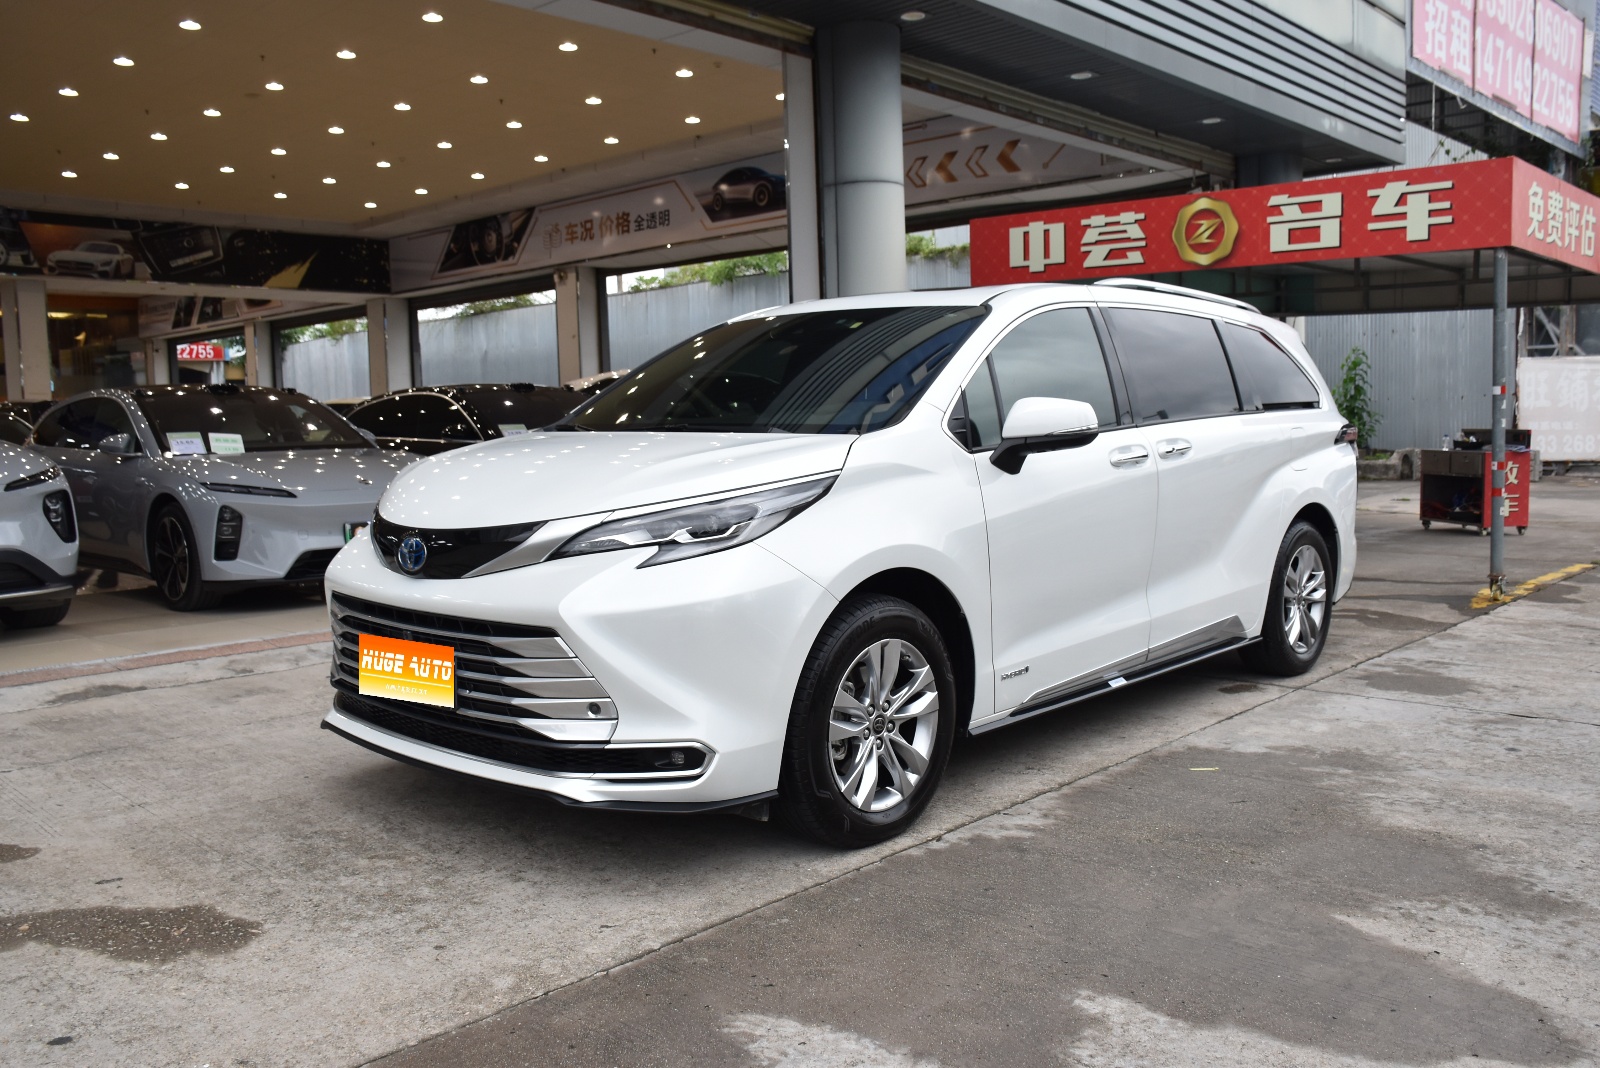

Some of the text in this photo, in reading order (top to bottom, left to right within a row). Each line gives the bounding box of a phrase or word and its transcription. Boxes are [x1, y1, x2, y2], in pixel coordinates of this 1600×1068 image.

[1425, 0, 1470, 75] 招租
[1475, 26, 1574, 128] 14714922755
[1008, 211, 1146, 273] 中荟
[1266, 180, 1454, 253] 名车
[1527, 181, 1596, 257] 免费评估
[1523, 368, 1600, 412] 旺铺
